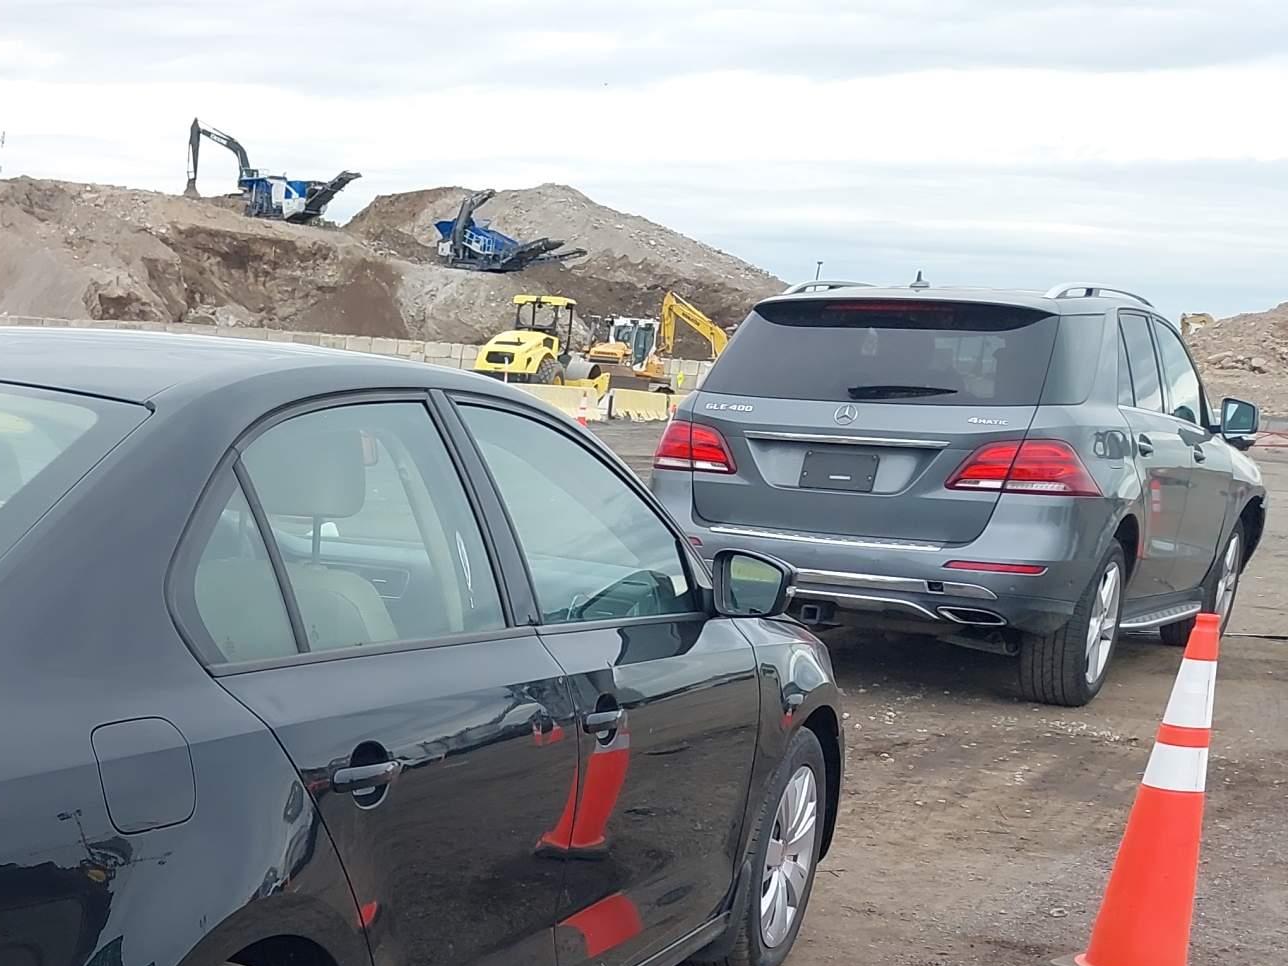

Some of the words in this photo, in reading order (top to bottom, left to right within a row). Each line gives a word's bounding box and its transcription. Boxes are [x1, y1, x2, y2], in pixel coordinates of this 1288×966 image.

[705, 402, 729, 411] GLE
[728, 404, 753, 412] 400
[967, 417, 1009, 426] 4MATIC
